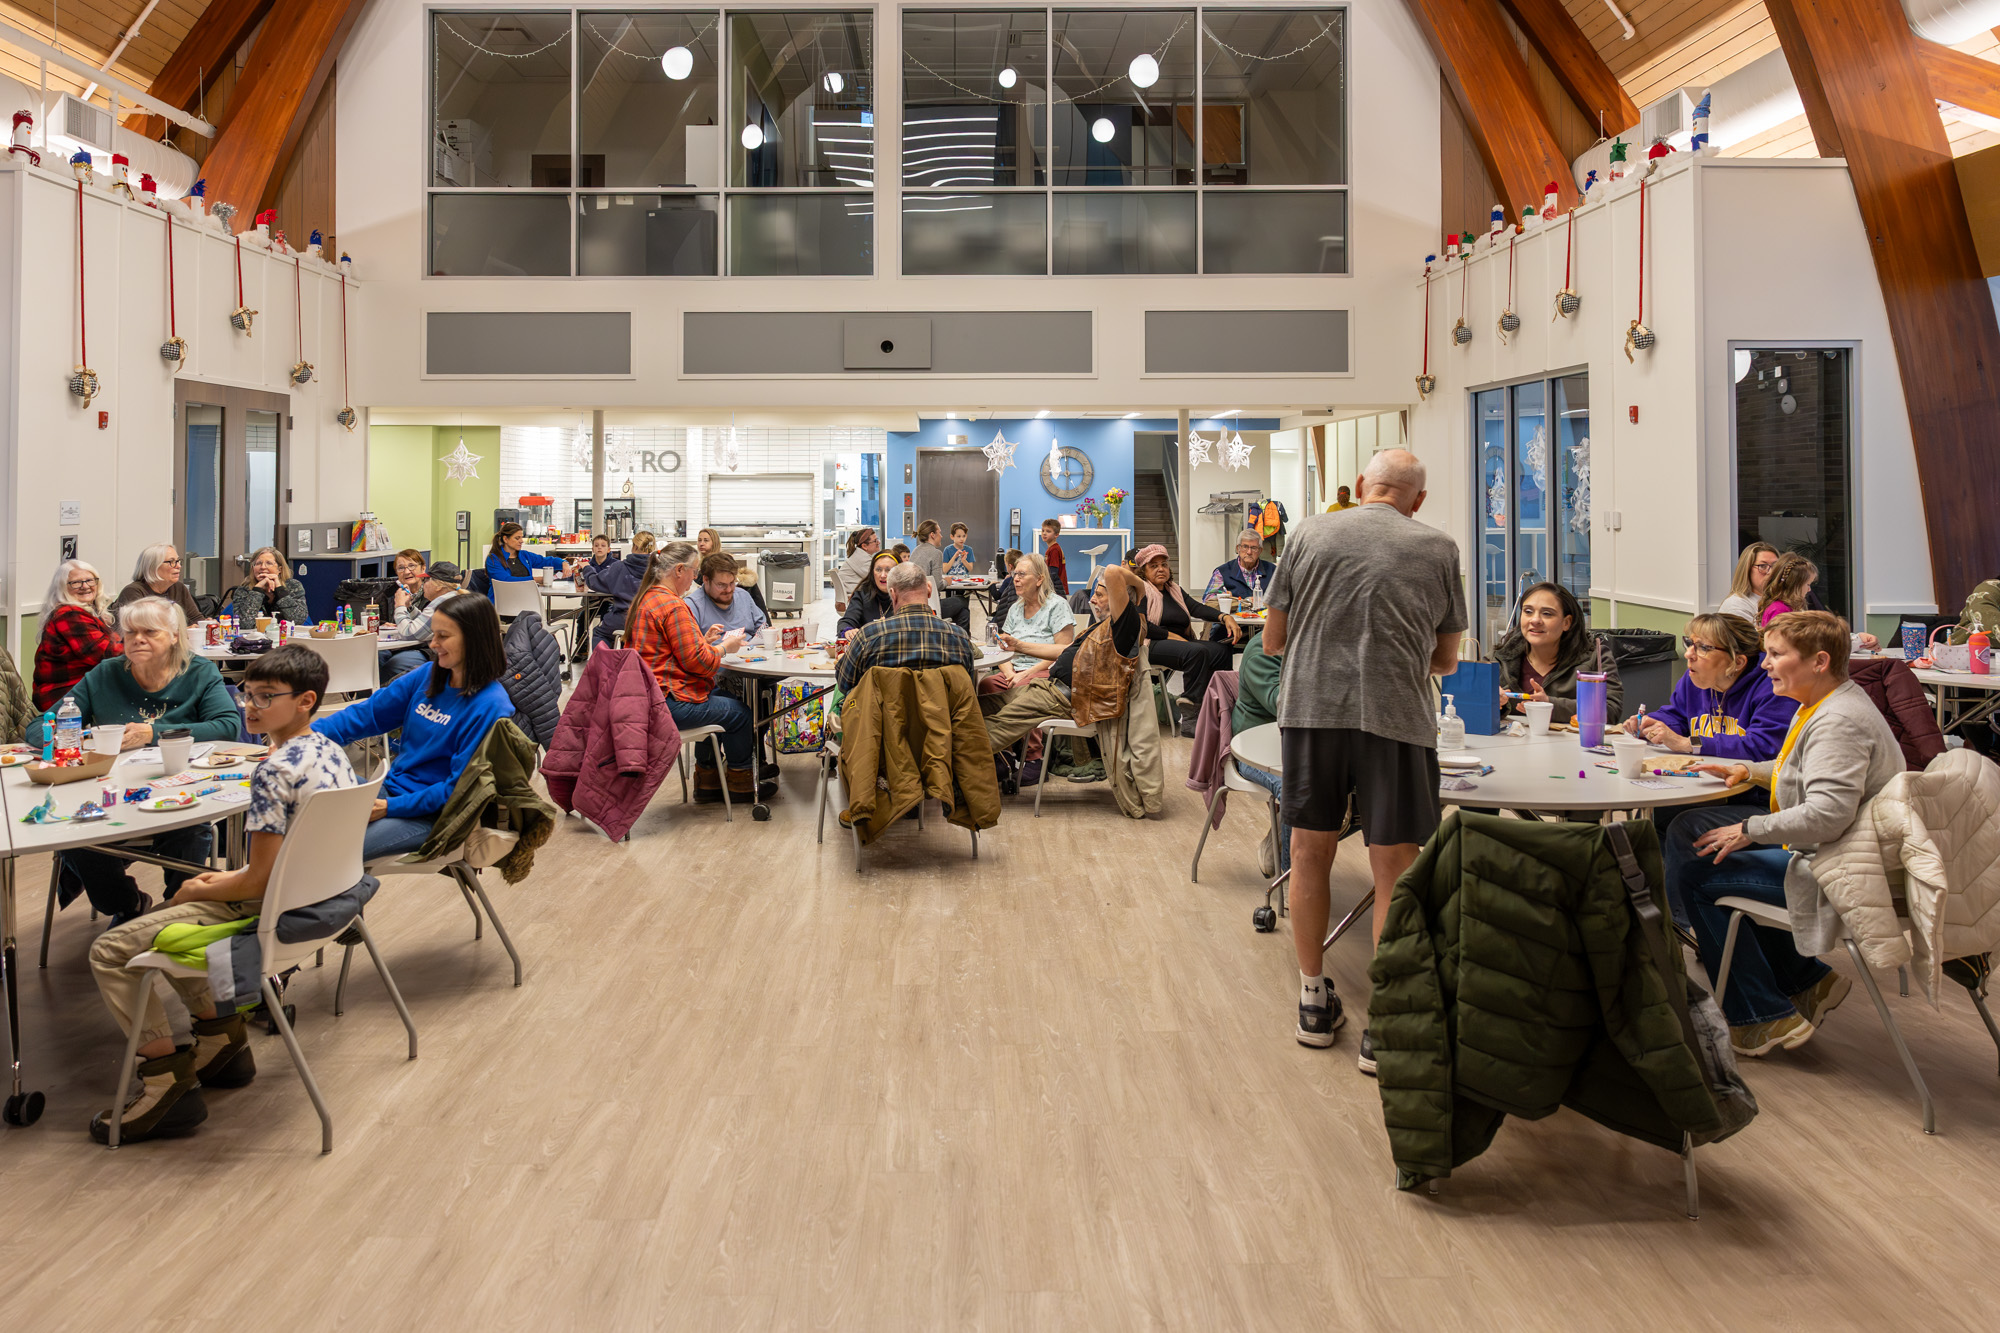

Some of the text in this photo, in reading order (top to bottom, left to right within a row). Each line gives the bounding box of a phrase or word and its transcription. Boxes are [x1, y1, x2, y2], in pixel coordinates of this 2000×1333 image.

[585, 433, 612, 444] TE
[585, 450, 681, 473] ISRO
[415, 703, 451, 725] slalom
